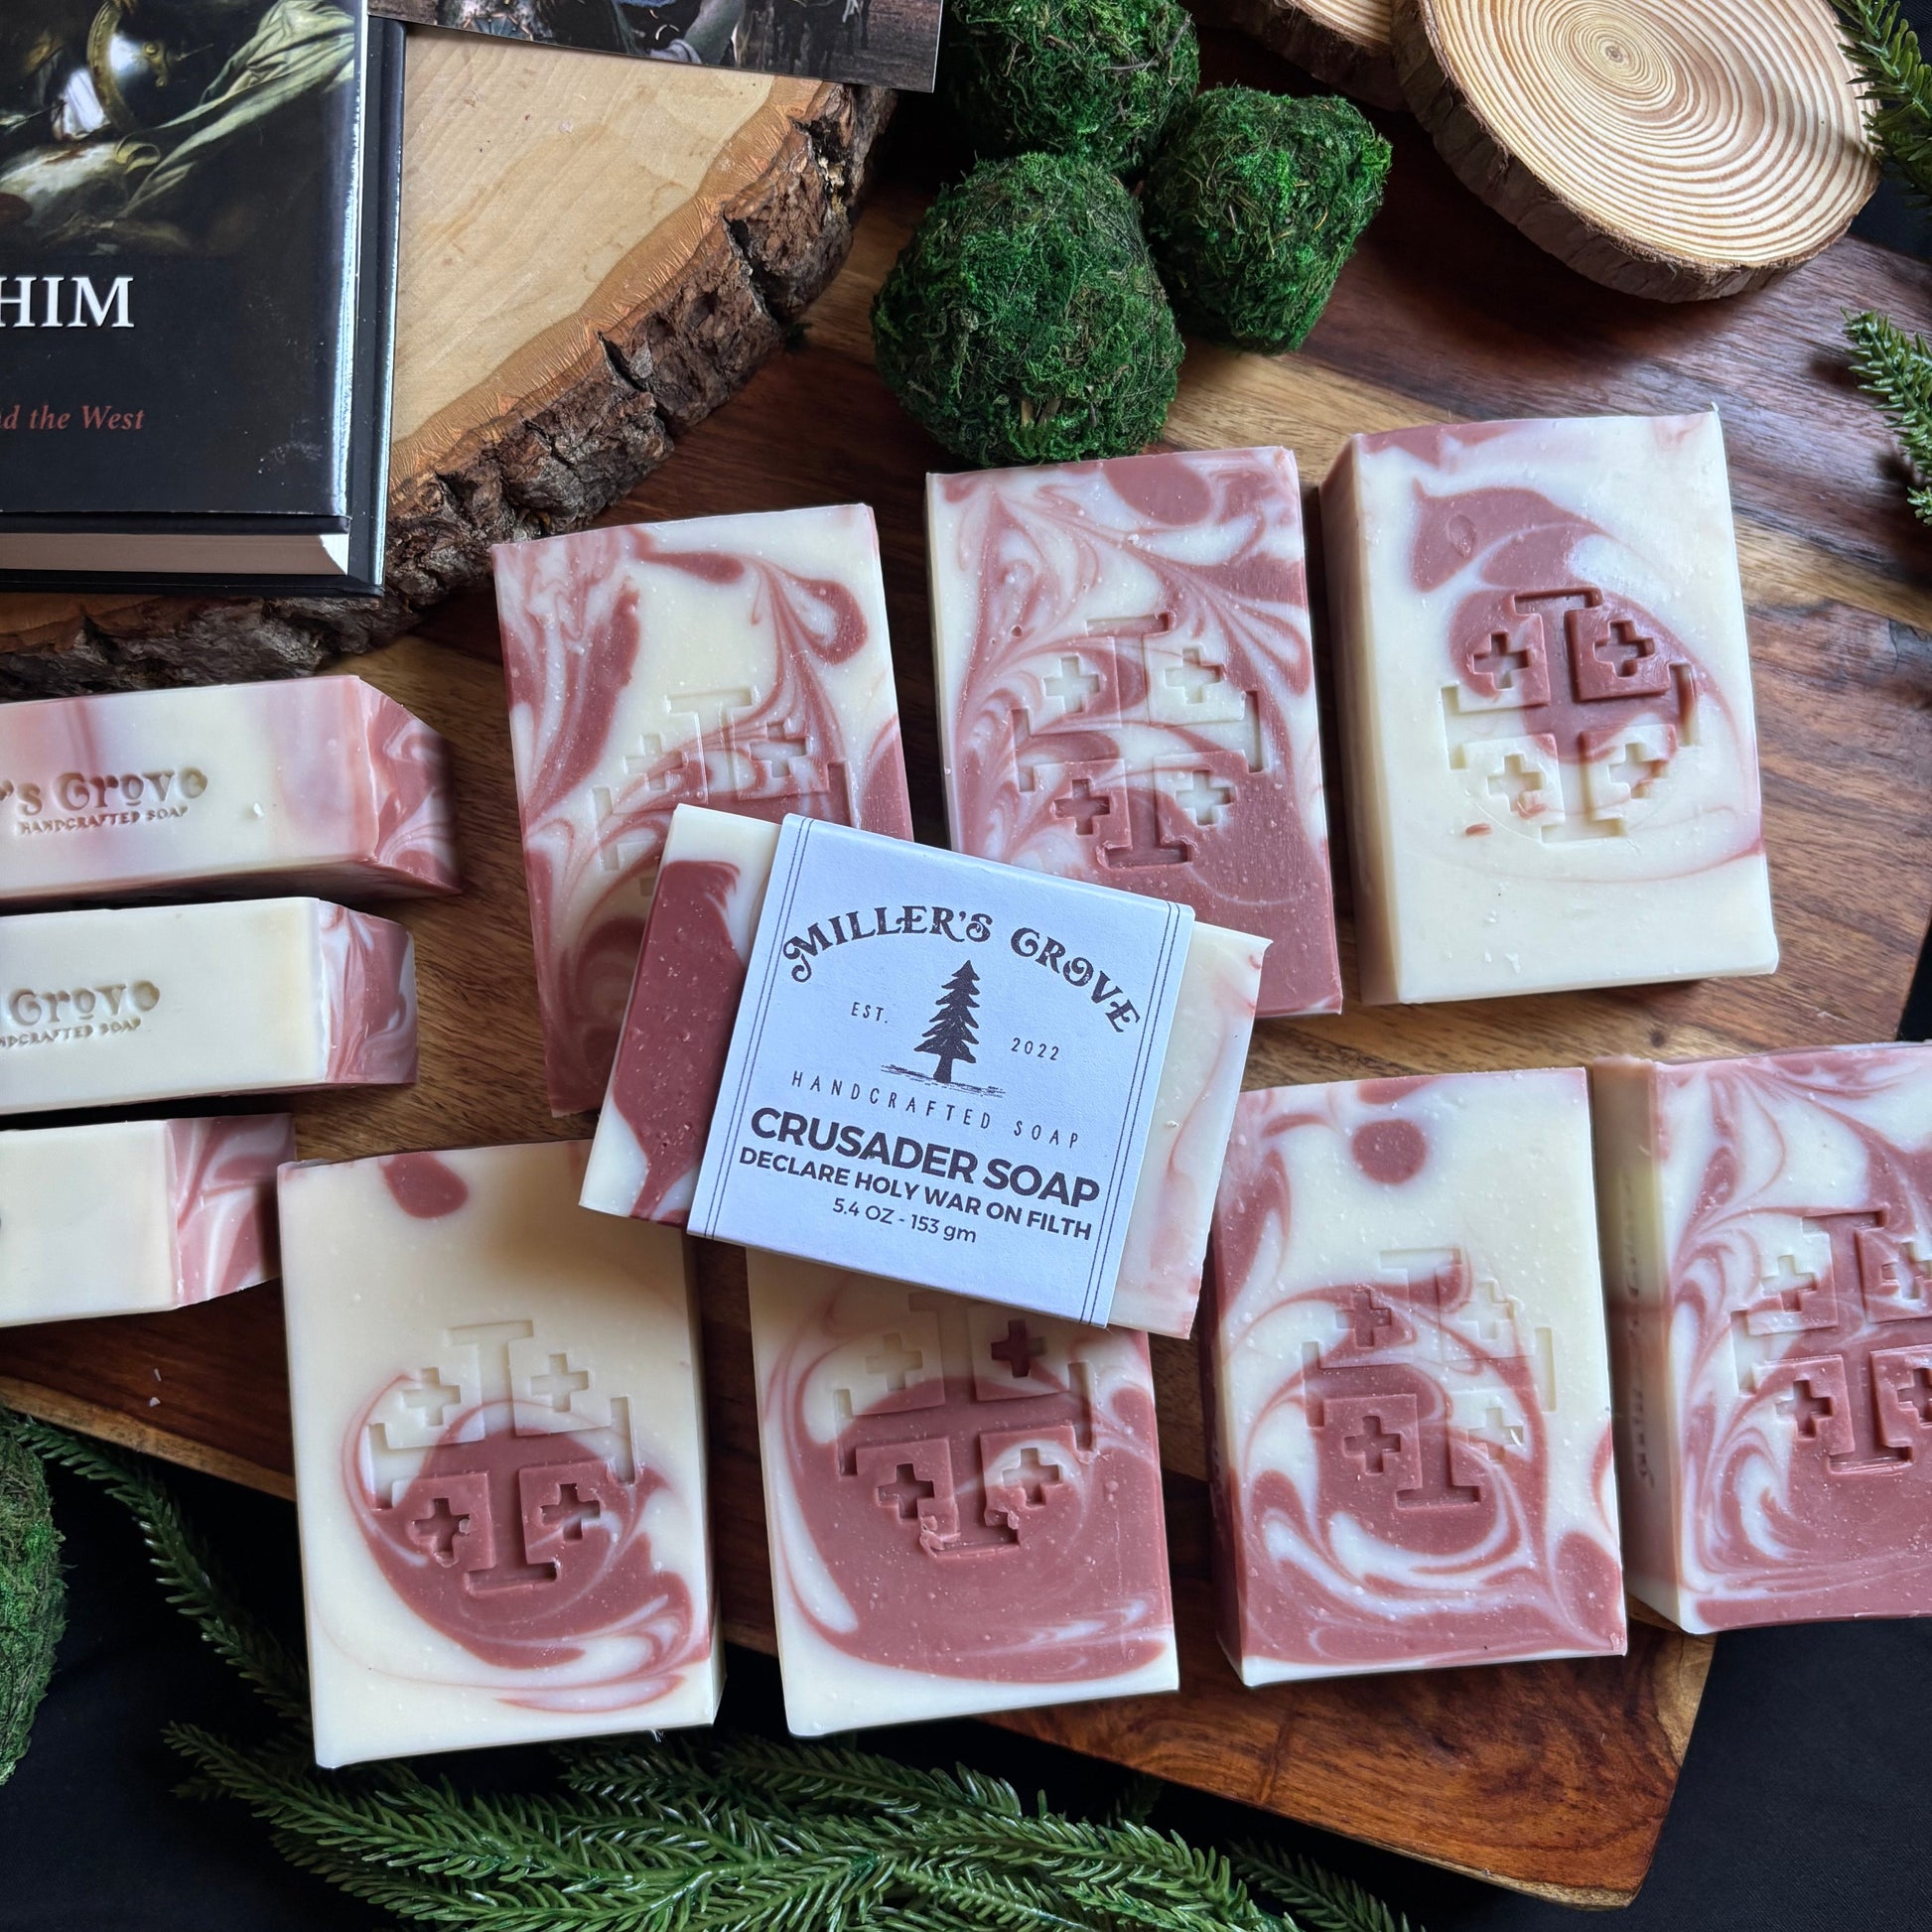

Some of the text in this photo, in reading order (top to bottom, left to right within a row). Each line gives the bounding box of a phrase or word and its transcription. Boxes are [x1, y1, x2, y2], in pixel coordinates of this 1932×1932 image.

[0, 275, 135, 328] HIM
[0, 404, 145, 430] d the West
[20, 804, 189, 835] HANDCRAFTED SOAP
[782, 905, 1141, 1033] MILLER'S GROVE
[100, 1016, 142, 1035] SOAP
[851, 1002, 1059, 1061] EST. 2022
[791, 1070, 1078, 1149] HANDCRAFTED SOAP
[751, 1107, 1100, 1208] CRUSADER SOAP
[739, 1146, 1092, 1241] DECLARE HOLY WAR ON FILTH
[832, 1197, 860, 1217] 5.4
[865, 1205, 896, 1225] OZ
[911, 1213, 940, 1234] 153
[943, 1224, 977, 1243] gm
